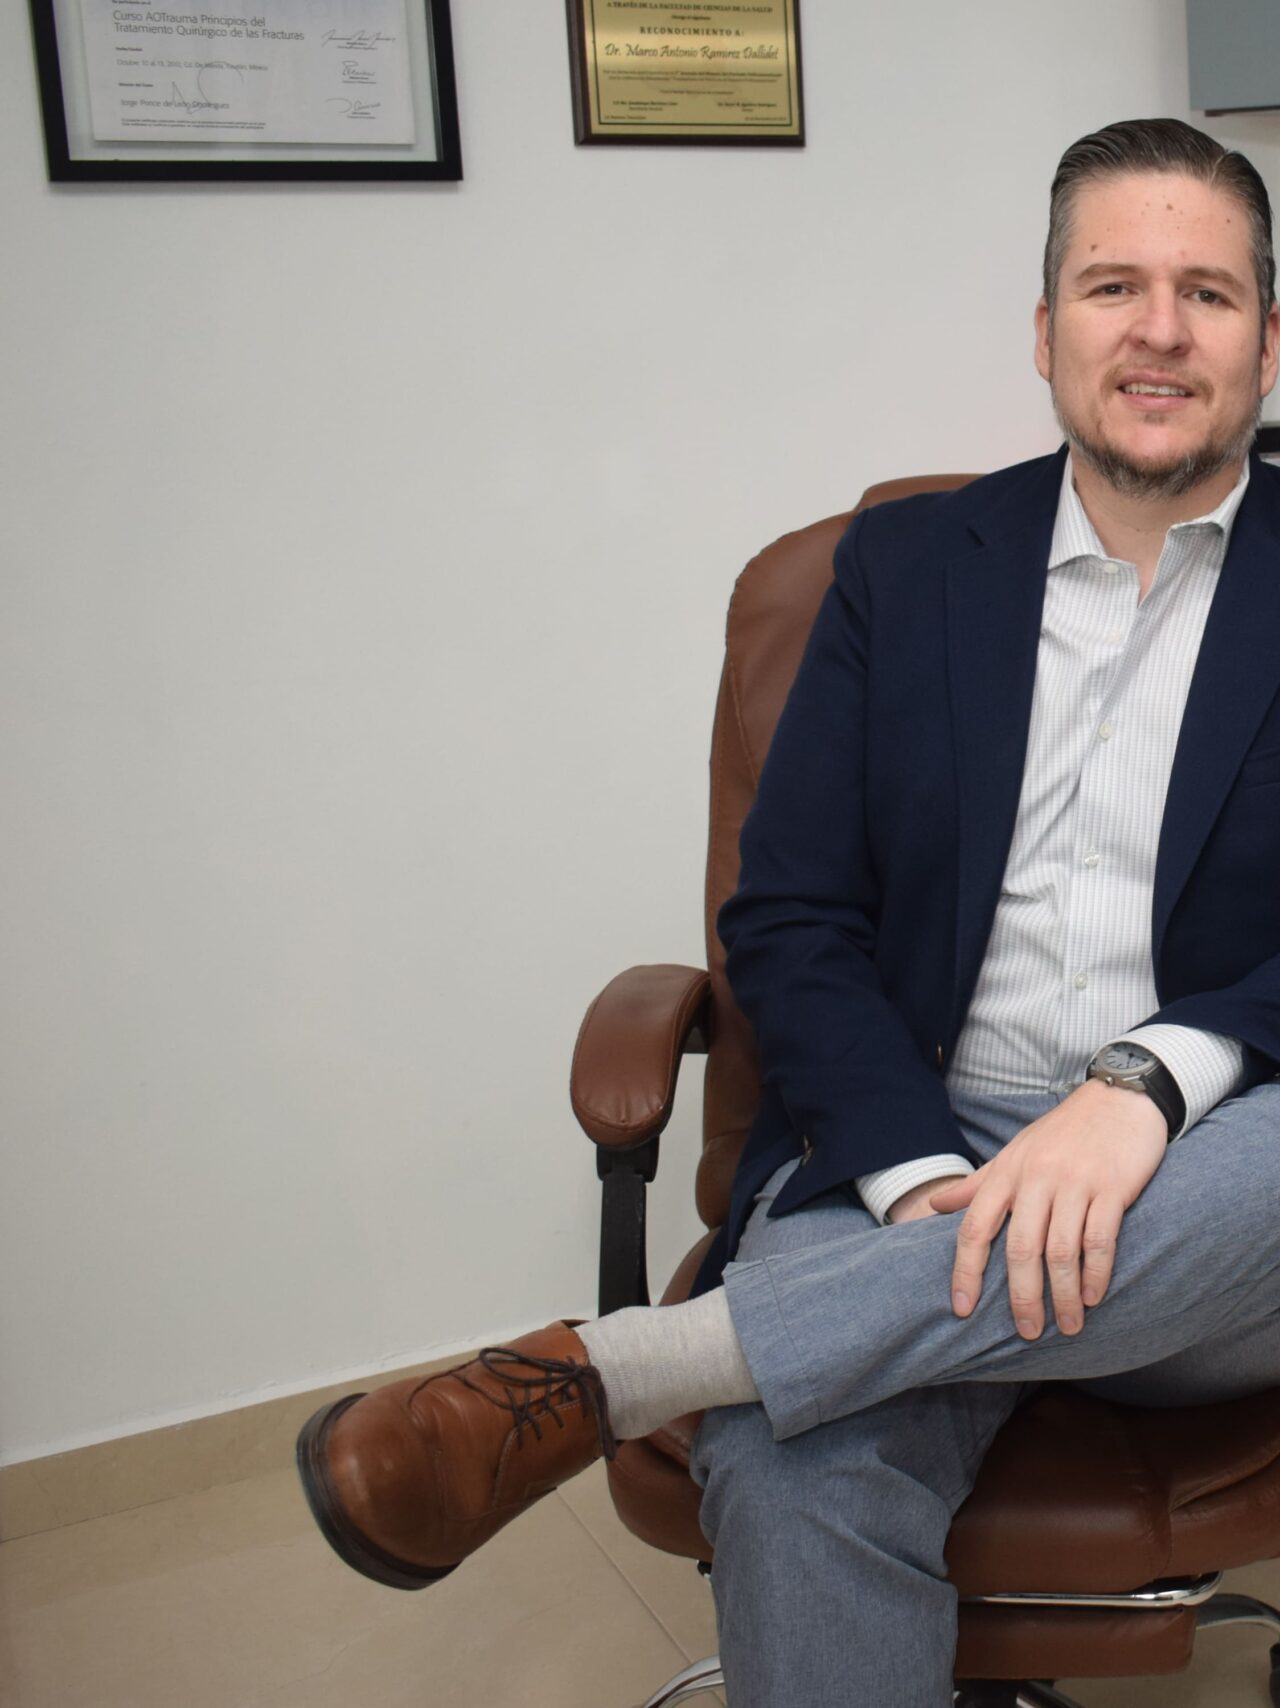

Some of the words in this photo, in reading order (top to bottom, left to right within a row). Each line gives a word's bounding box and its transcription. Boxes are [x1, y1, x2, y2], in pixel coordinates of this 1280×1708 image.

[113, 10, 143, 22] Curso
[146, 12, 198, 24] AOTrauma
[201, 14, 248, 28] Principios
[250, 17, 266, 27] del
[114, 22, 174, 34] Tratamiento
[176, 25, 227, 39] Quirúrgico
[230, 27, 243, 37] de
[246, 28, 260, 39] las
[261, 29, 304, 41] Fracturas
[640, 26, 732, 36] RECONOCIMIENTO
[605, 43, 621, 56] Dr.
[625, 43, 659, 56] Marco
[660, 45, 698, 57] Antonio
